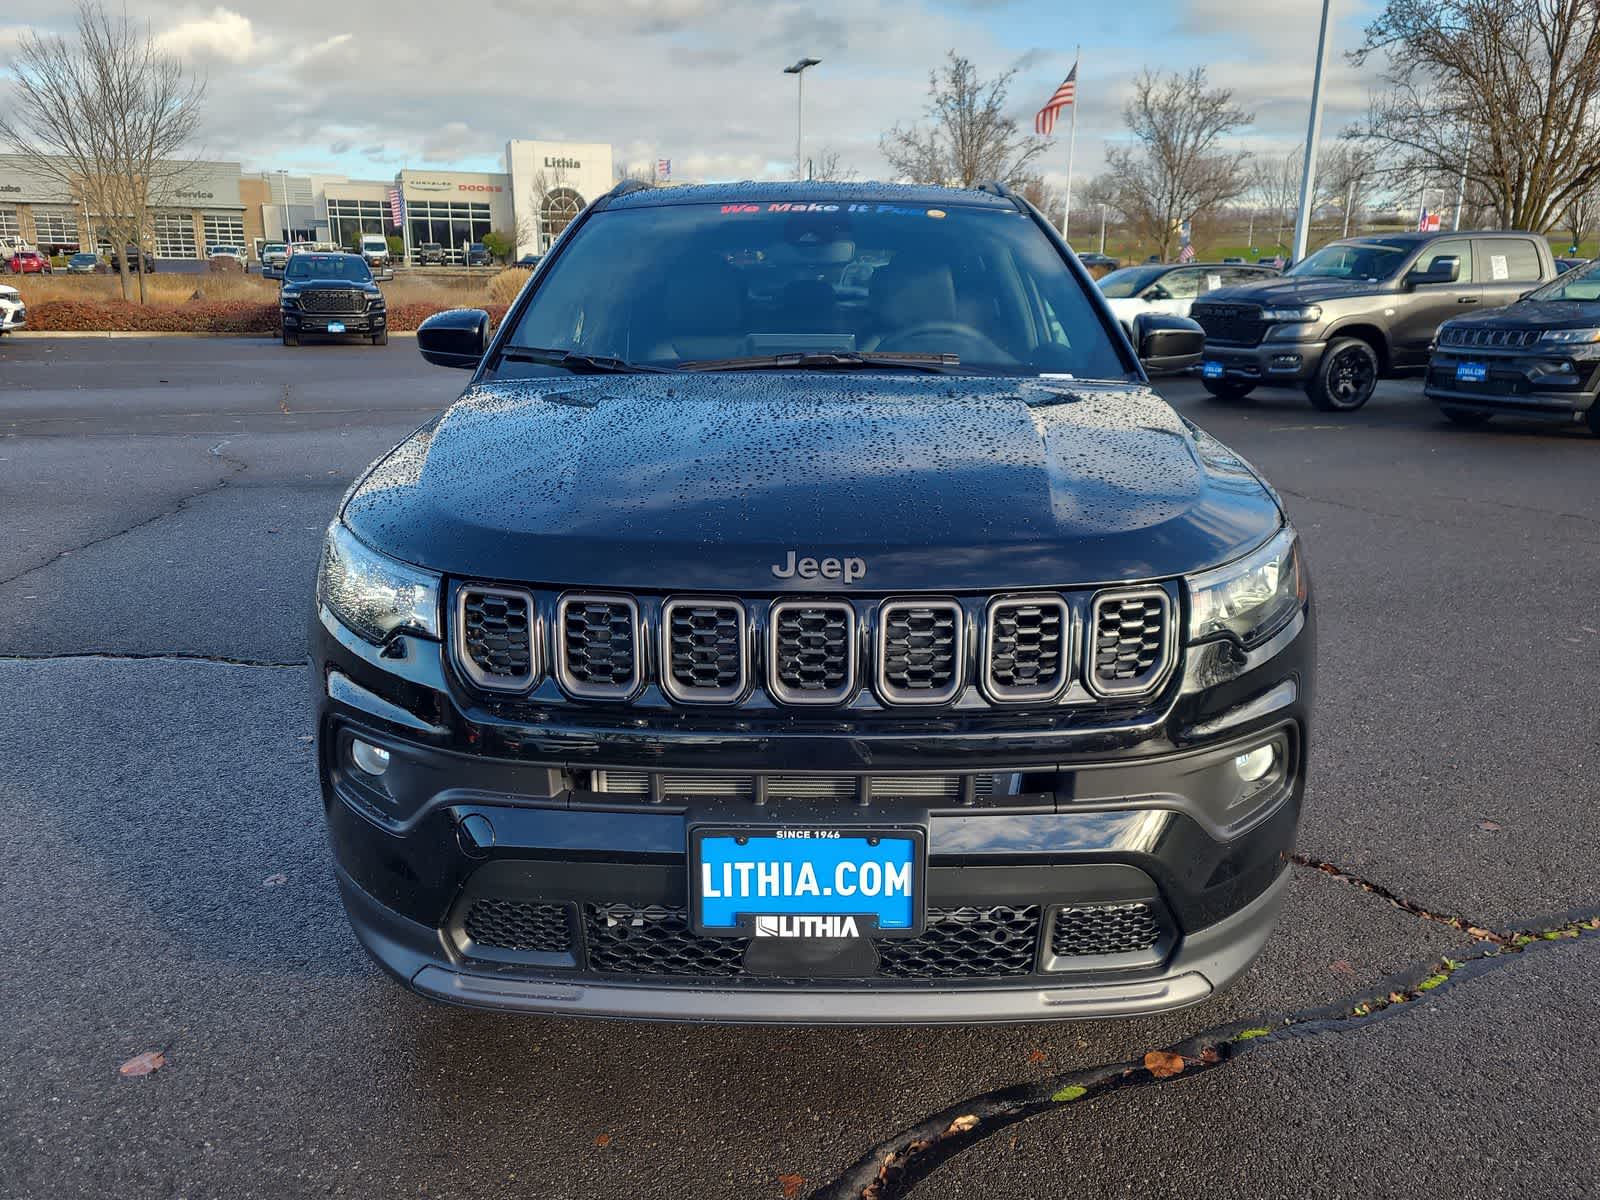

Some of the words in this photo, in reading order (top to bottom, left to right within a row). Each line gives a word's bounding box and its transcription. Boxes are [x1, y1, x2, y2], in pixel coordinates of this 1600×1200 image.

[544, 156, 581, 169] Lithia
[0, 184, 21, 193] ube
[175, 189, 214, 199] Service
[458, 184, 503, 193] DODGE
[720, 203, 760, 214] We
[768, 203, 840, 213] Make
[848, 204, 869, 213] It
[771, 550, 866, 584] Jeep
[776, 830, 811, 839] SINCE
[814, 830, 840, 839] 1946
[702, 861, 913, 897] LITHIA.COM
[779, 916, 860, 938] LITHIA
